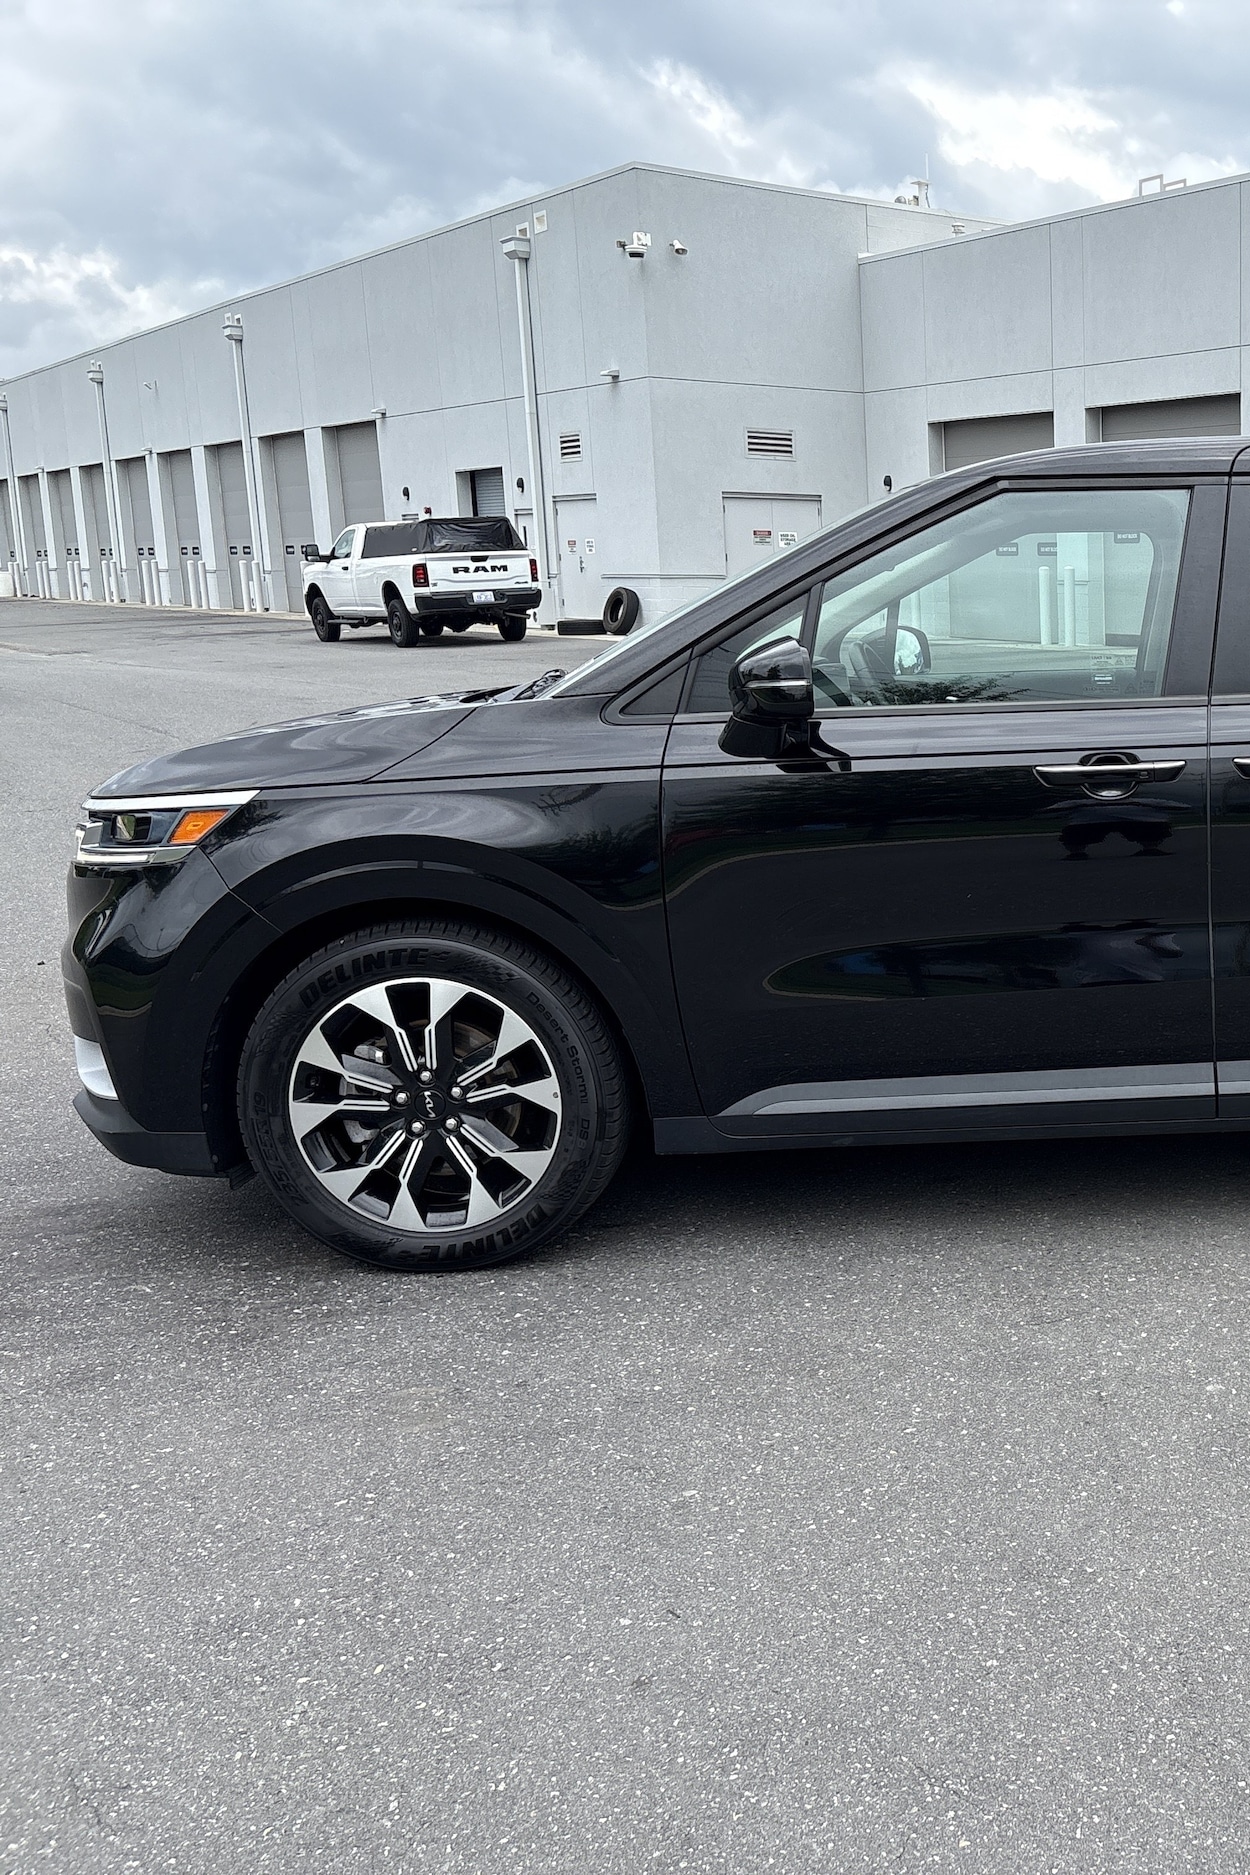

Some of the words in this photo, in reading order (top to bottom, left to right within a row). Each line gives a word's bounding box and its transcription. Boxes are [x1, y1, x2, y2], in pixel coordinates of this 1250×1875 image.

[452, 564, 508, 574] RAM
[298, 947, 431, 1007] DELINTE
[525, 991, 569, 1044] Desert
[422, 1205, 549, 1263] DELINTE
